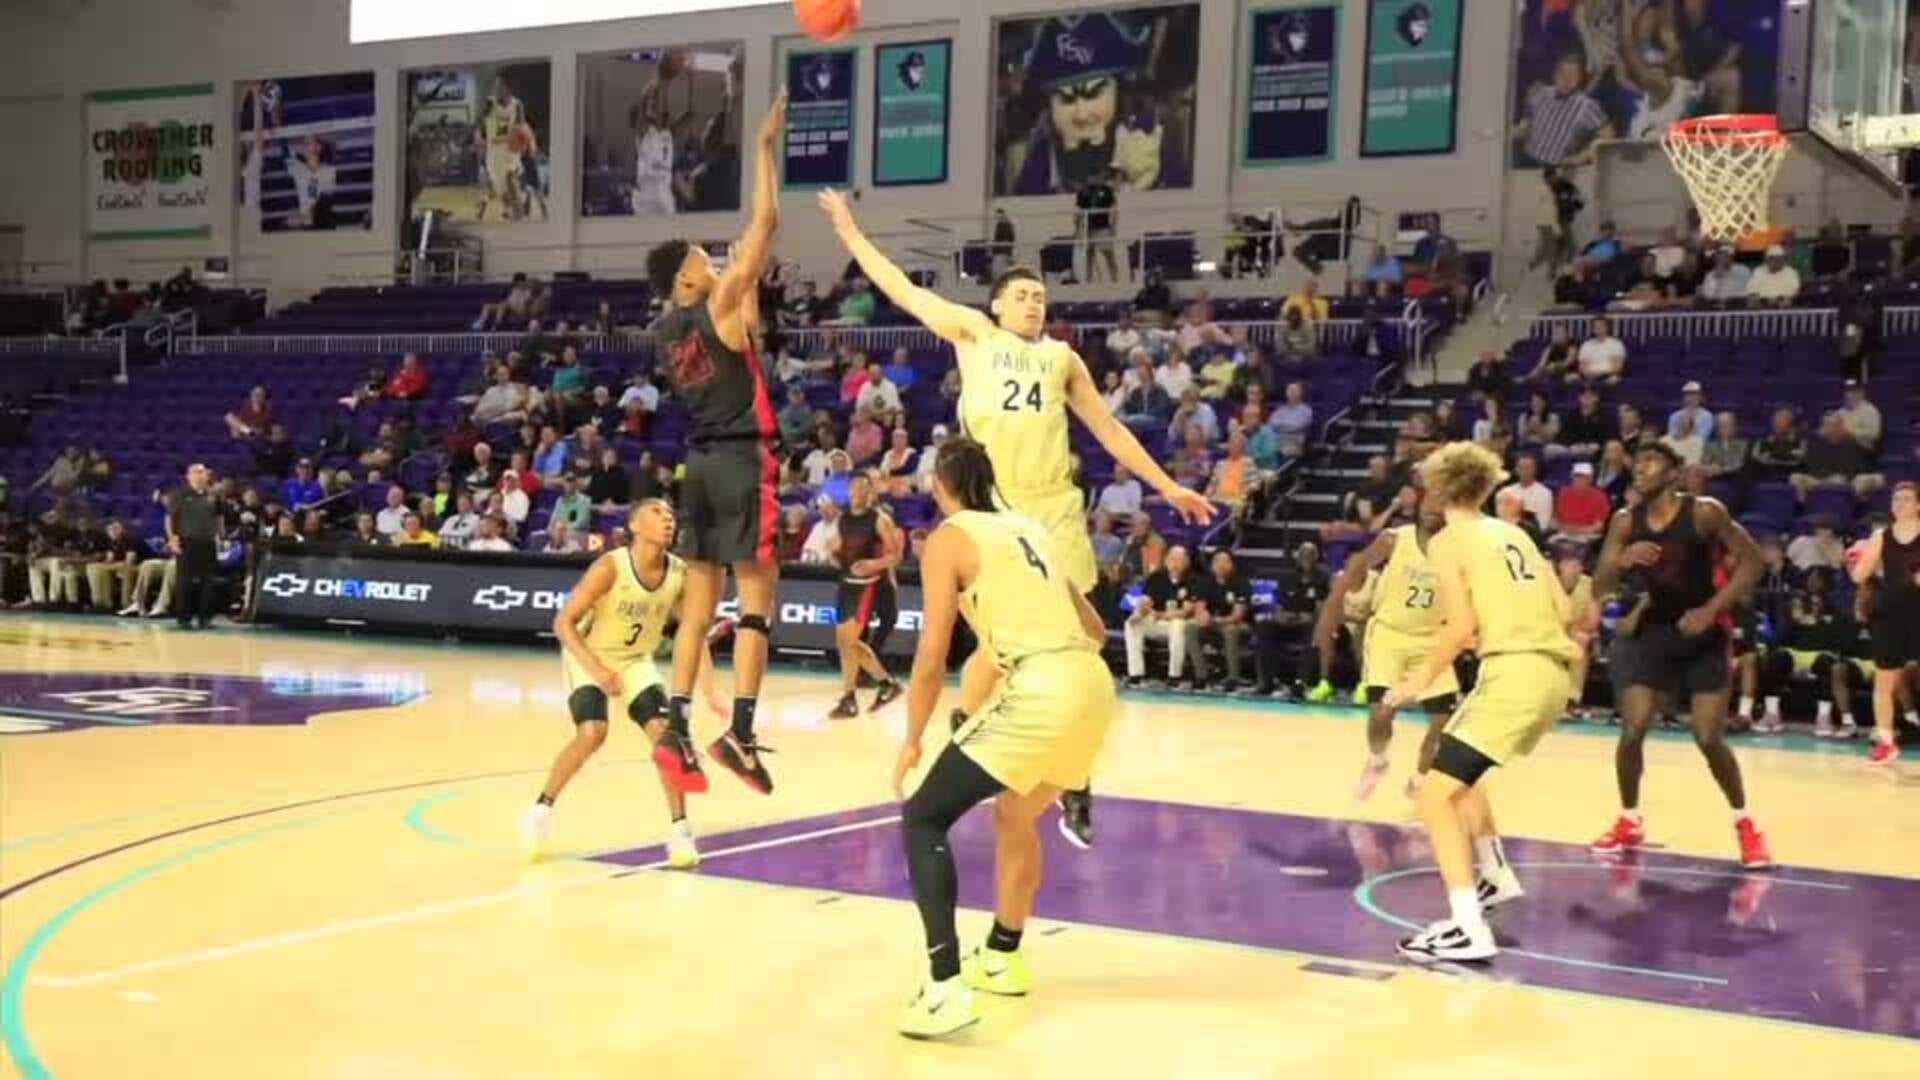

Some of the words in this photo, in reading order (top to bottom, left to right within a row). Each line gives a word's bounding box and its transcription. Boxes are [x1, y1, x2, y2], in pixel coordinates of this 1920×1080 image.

[92, 123, 214, 153] CROWTHER
[103, 154, 202, 183] ROOFING
[1002, 379, 1042, 413] 24
[1016, 536, 1049, 581] 4
[1504, 544, 1536, 581] 12
[313, 579, 432, 601] CHEVROLET
[1405, 585, 1435, 609] 23
[624, 623, 643, 647] 3
